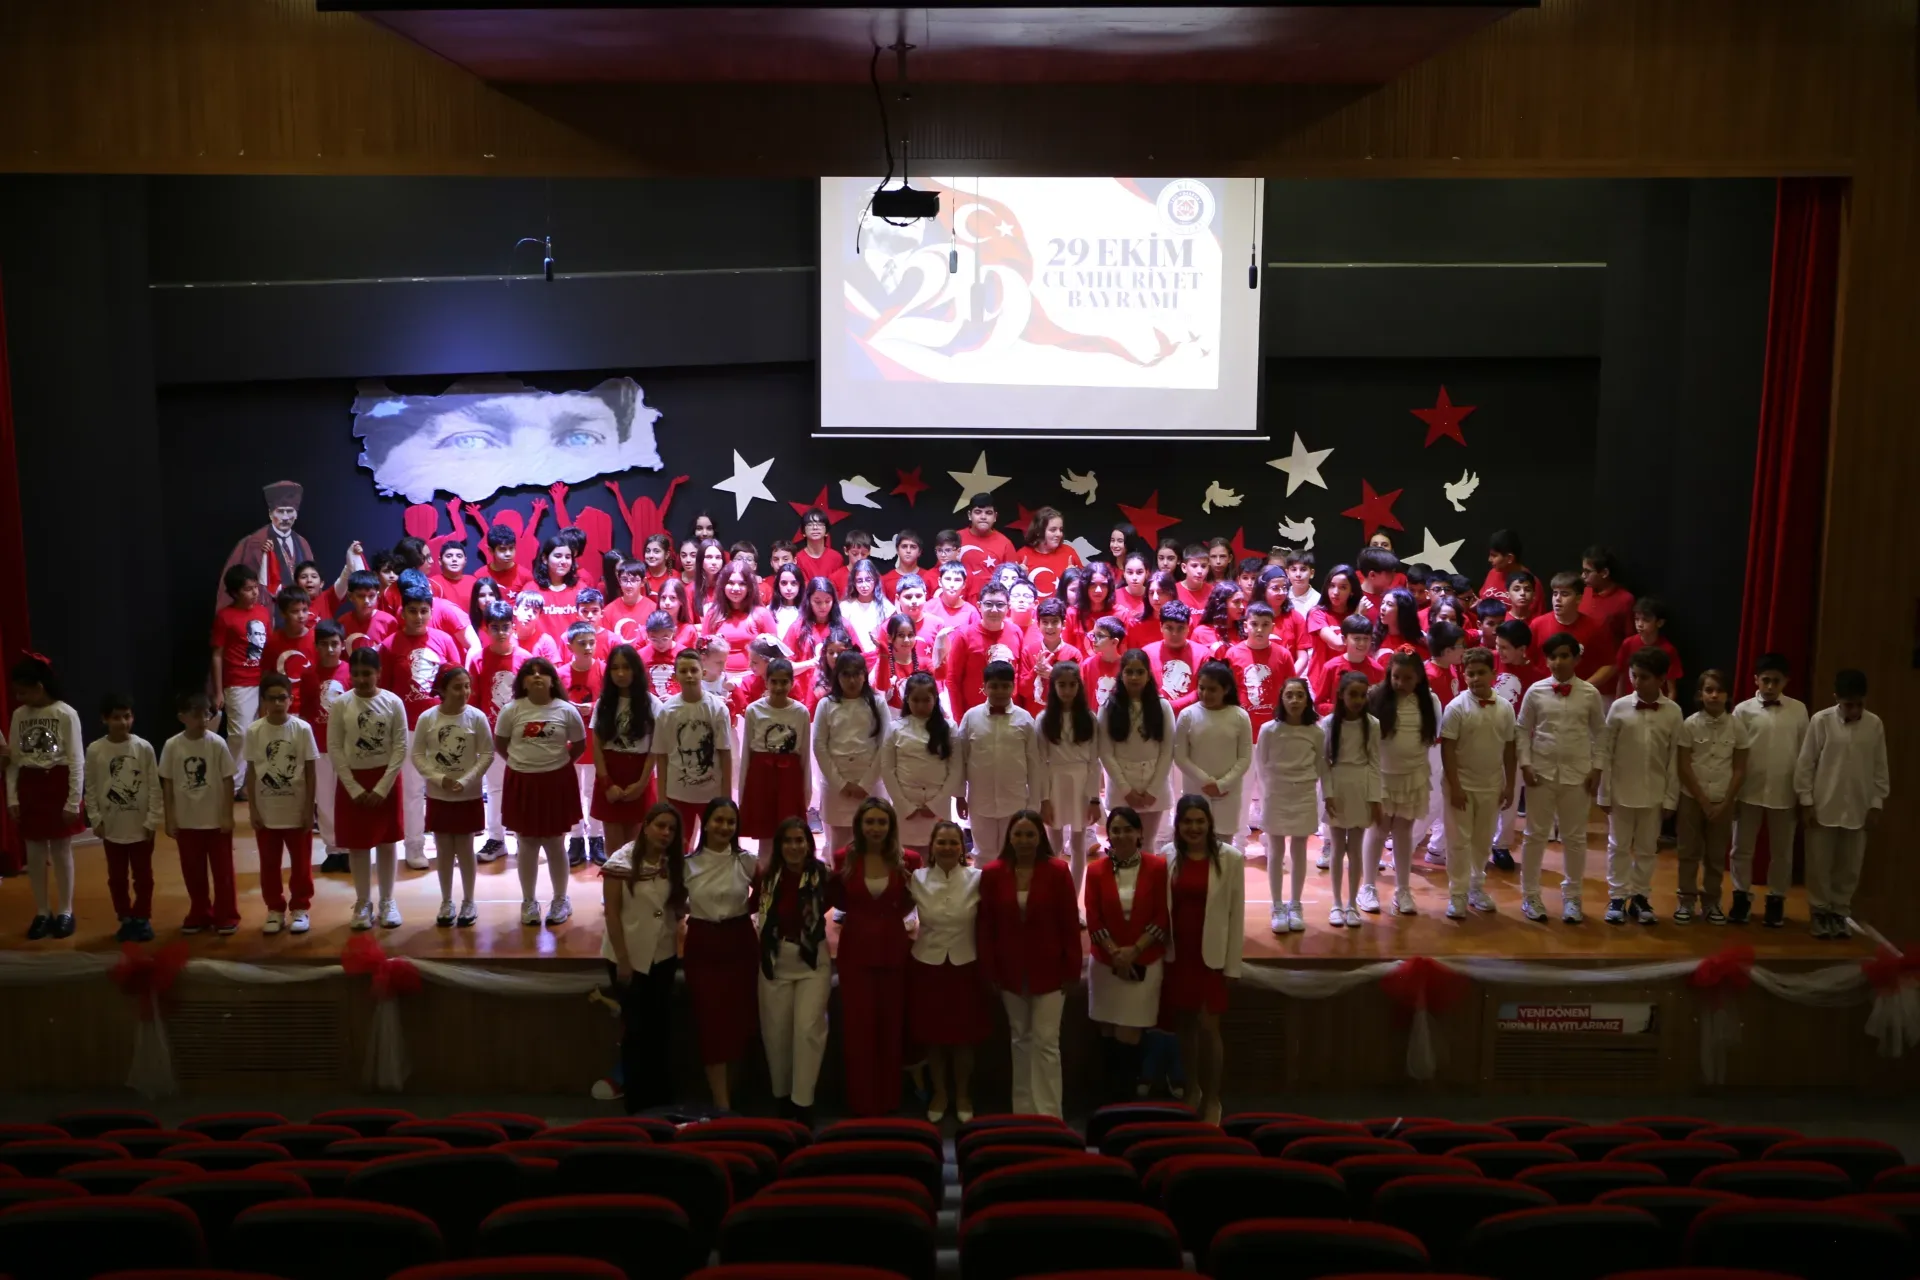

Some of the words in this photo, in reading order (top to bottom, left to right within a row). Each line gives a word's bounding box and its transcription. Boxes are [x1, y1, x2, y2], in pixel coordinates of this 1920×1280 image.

[1047, 237, 1090, 266] 29
[1097, 232, 1195, 268] EKİM
[1042, 268, 1203, 290] CUMHURİYET
[1068, 291, 1178, 309] BAYRAMI
[1519, 1006, 1545, 1018] YENİ
[1547, 1005, 1589, 1018] DÖNEM
